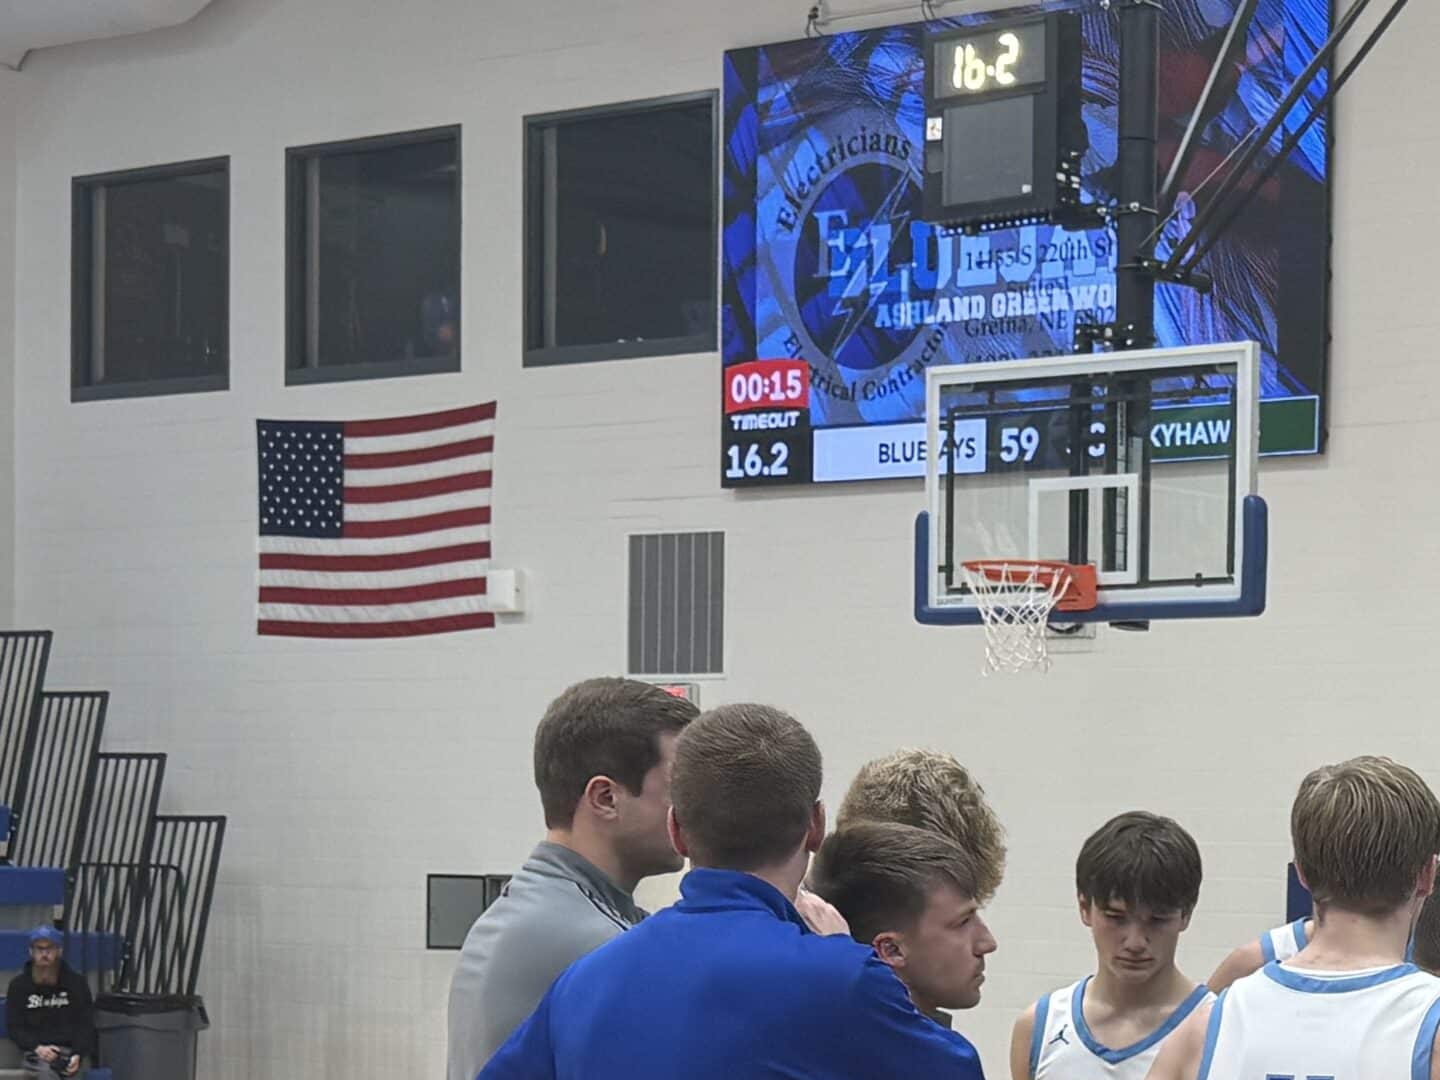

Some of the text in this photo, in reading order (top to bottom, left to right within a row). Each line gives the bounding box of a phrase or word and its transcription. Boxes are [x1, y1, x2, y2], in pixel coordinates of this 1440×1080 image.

[952, 33, 1019, 90] 16.2
[731, 368, 802, 404] 00:15
[730, 411, 801, 431] TIMEOUT
[726, 442, 789, 478] 16.2
[879, 436, 976, 464] BLUEAYS
[1000, 426, 1040, 463] 59
